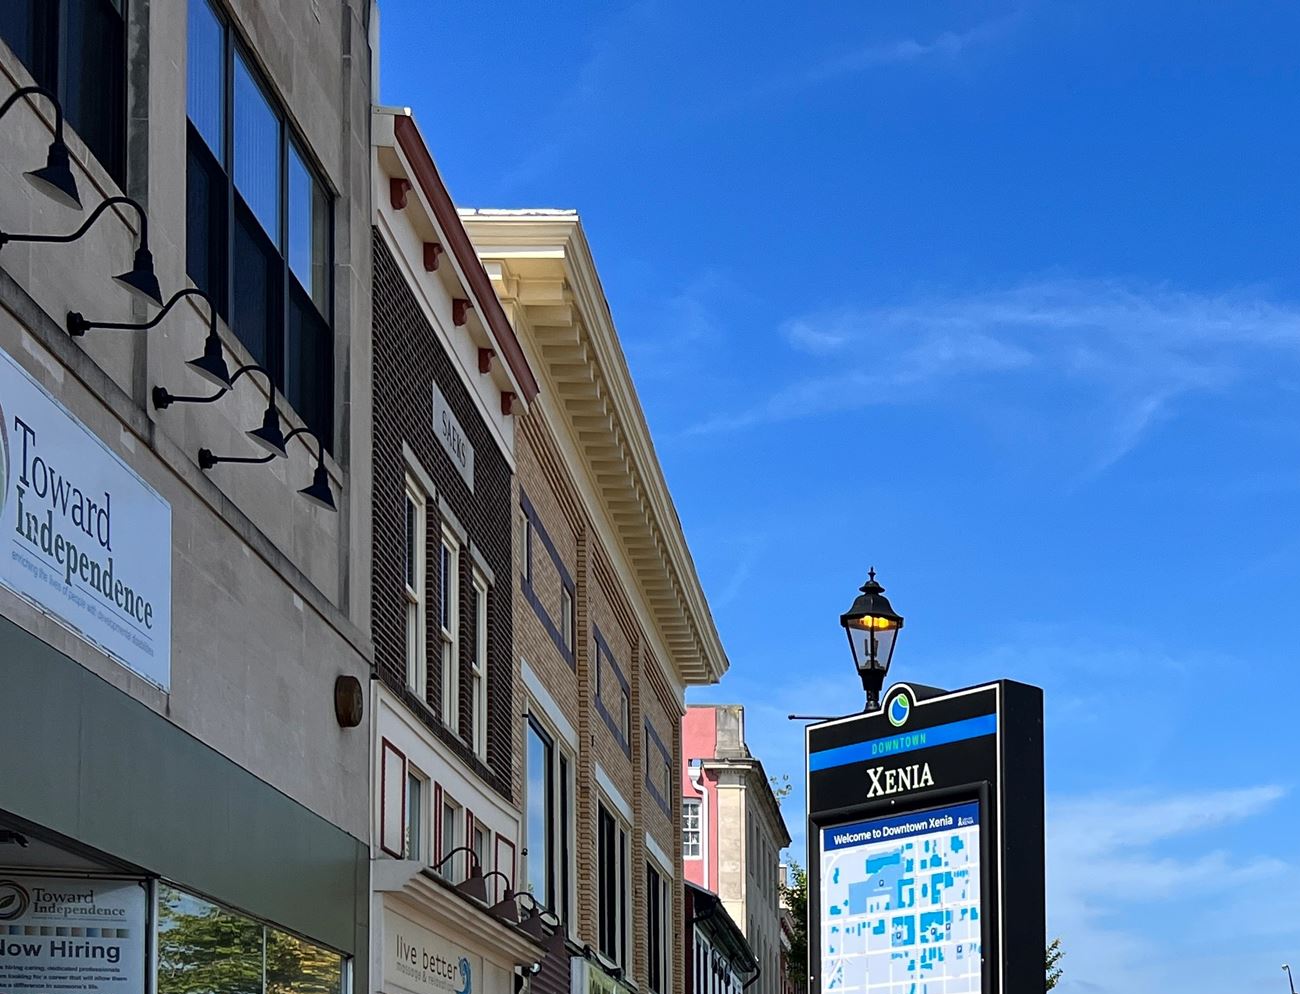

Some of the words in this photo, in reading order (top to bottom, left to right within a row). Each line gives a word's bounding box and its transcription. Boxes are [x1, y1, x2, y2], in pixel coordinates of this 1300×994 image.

[15, 415, 112, 552] Toward
[16, 484, 153, 629] Independence
[871, 732, 926, 755] DOWNTOWN
[866, 762, 935, 798] XENIA
[833, 831, 871, 845] Welcome
[872, 830, 881, 839] to
[882, 821, 928, 837] Downtown
[929, 814, 953, 829] Xenia
[32, 888, 94, 904] Toward
[34, 902, 126, 918] Independence
[50, 941, 120, 963] Hiring
[396, 934, 417, 965] live
[423, 947, 458, 981] better
